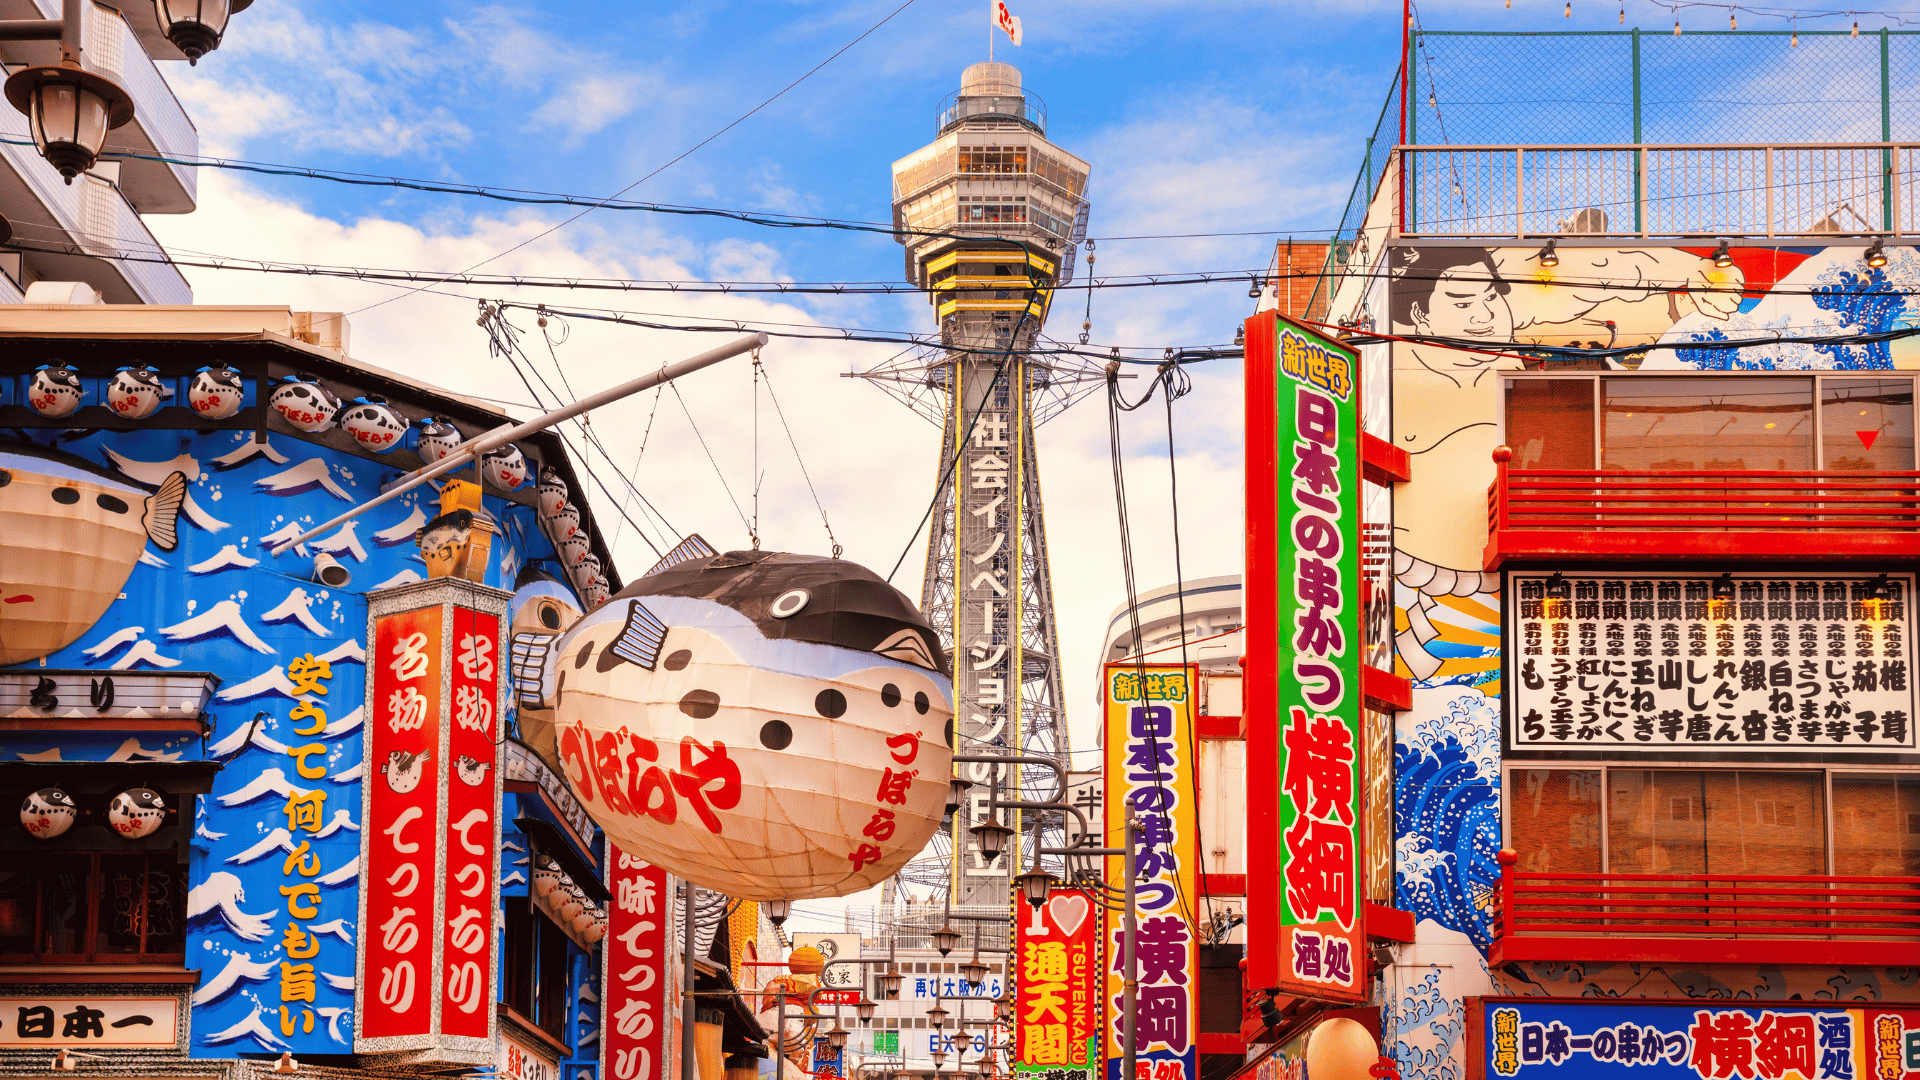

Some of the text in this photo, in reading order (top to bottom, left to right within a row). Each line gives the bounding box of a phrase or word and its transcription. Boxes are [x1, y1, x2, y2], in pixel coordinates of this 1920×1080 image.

[1521, 580, 1544, 620] 前頭
[1575, 580, 1600, 620] 前頭
[1715, 623, 1735, 656] 大地の幸
[1822, 581, 1848, 621] 前頭
[1826, 623, 1846, 657] 大地の幸
[1854, 623, 1874, 657] 大地の幸
[1883, 624, 1902, 657] 大地の幸
[1114, 673, 1187, 701] 新世界
[1281, 334, 1354, 981] 新世界 日本一の串かつ 横綱 酒処
[1521, 658, 1545, 740] もち
[1548, 658, 1576, 740] うずら玉子
[1575, 658, 1602, 740] 紅しょうが
[1602, 580, 1629, 741] 前頭 大地の幸 にんにく
[1630, 580, 1658, 741] 前頭 大地の幸 玉ねぎ
[1657, 580, 1684, 741] 前頭 大地の幸 山芋
[1684, 580, 1712, 741] 前頭 大地の幸 しし唐
[1739, 581, 1768, 742] 前頭 大地の幸 銀杏
[1767, 581, 1796, 742] 前頭 大地の幸 白ねぎ
[1795, 581, 1823, 742] 前頭 大地の幸 さつま芋
[1713, 659, 1740, 742] れんこん
[1852, 660, 1880, 743] 茄子
[1879, 660, 1907, 743] 椎茸
[561, 720, 741, 834] づぼらや
[848, 730, 923, 872] づぼらや
[1127, 705, 1175, 910] 日本一の串かつ
[279, 653, 332, 1037] 安うて何んでも旨い
[379, 632, 429, 1013] 名物 てっちり
[448, 632, 493, 1014] 名物 てっちり
[0, 1005, 153, 1038] 日本一
[915, 978, 1016, 998] 再び大阪から
[1023, 941, 1069, 1065] 通天閣
[1072, 941, 1087, 1064] TSUTENKAKU
[1114, 916, 1188, 1053] 横綱
[1495, 1010, 1518, 1073] 新世界
[1522, 1012, 1817, 1079] 日本一の串かつ 横綱
[1819, 1016, 1852, 1079] 酒処
[1878, 1017, 1902, 1080] 新世界
